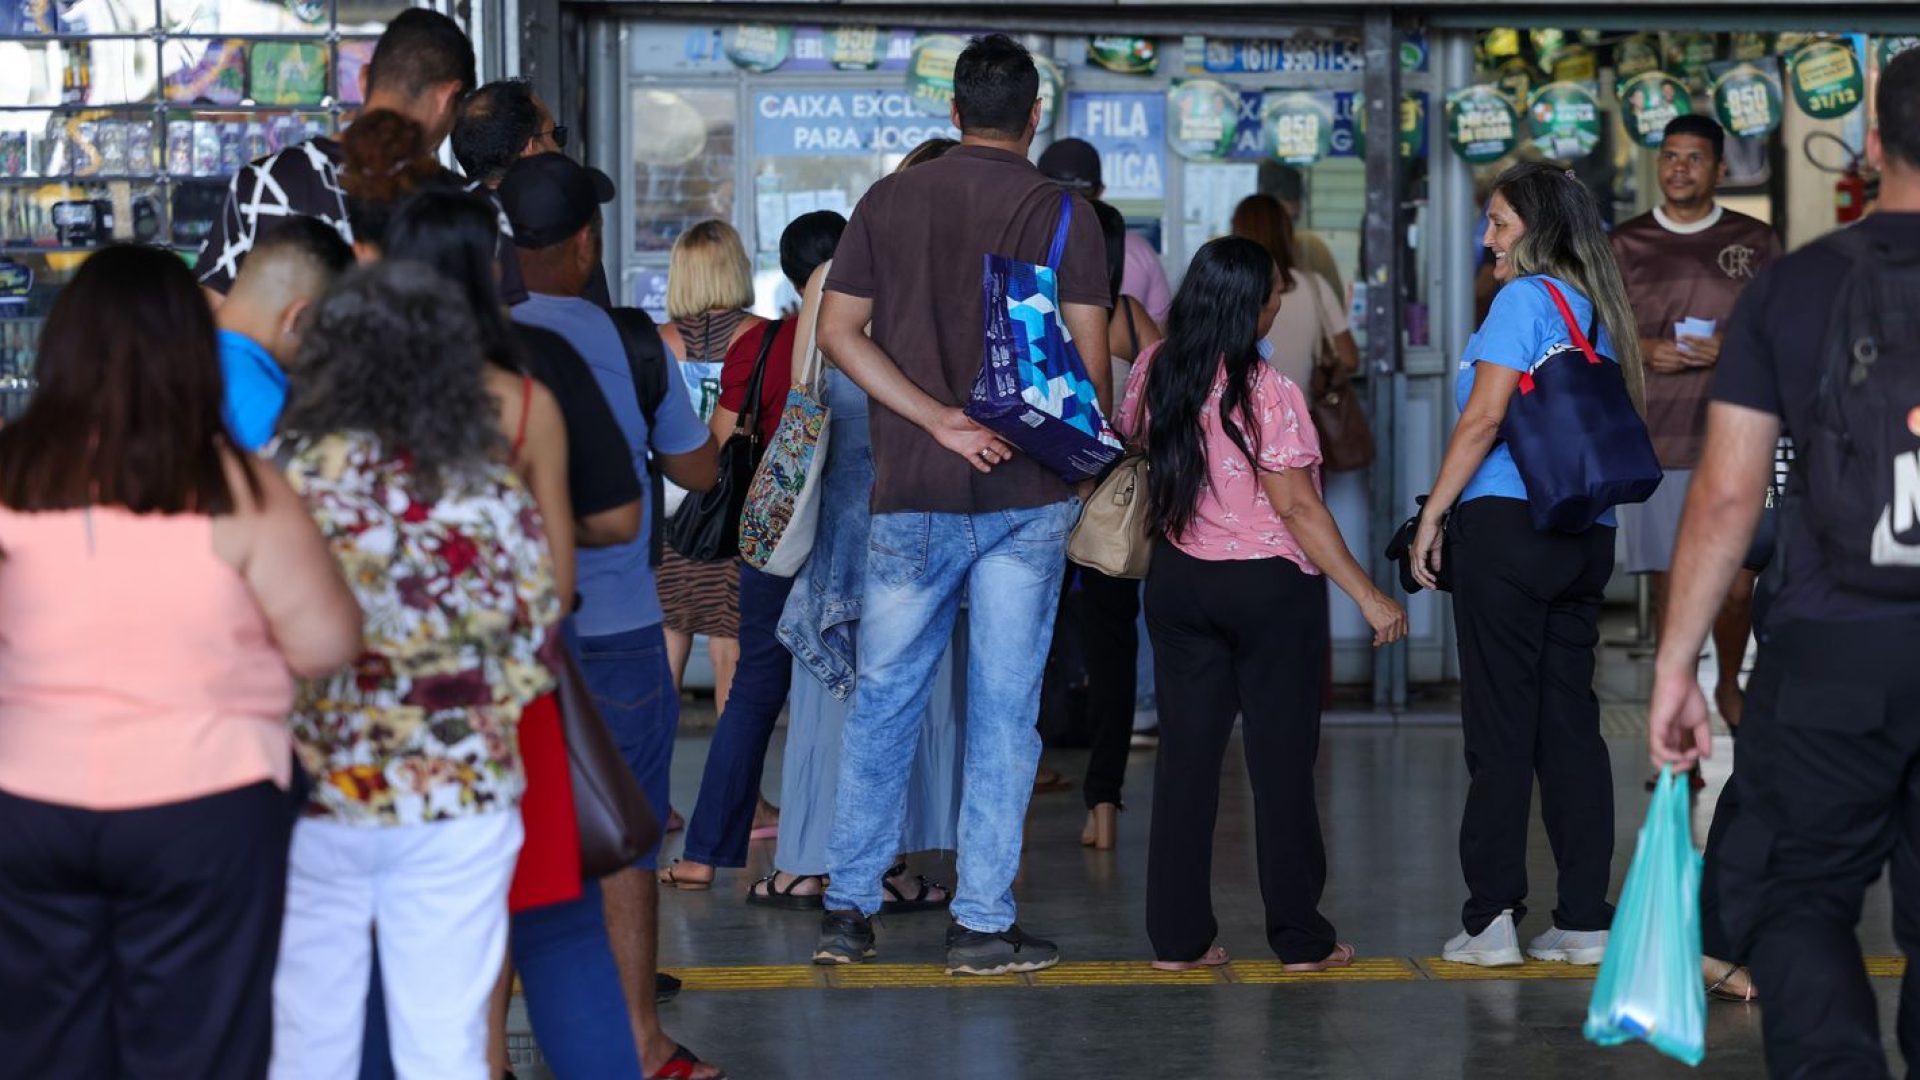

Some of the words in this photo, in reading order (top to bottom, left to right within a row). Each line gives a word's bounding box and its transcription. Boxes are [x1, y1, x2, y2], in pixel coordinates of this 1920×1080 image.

[760, 95, 844, 118] CAIXA
[852, 96, 926, 118] EXCL
[1087, 101, 1148, 136] FILA
[794, 126, 861, 149] PARA
[1101, 152, 1163, 189] ICA
